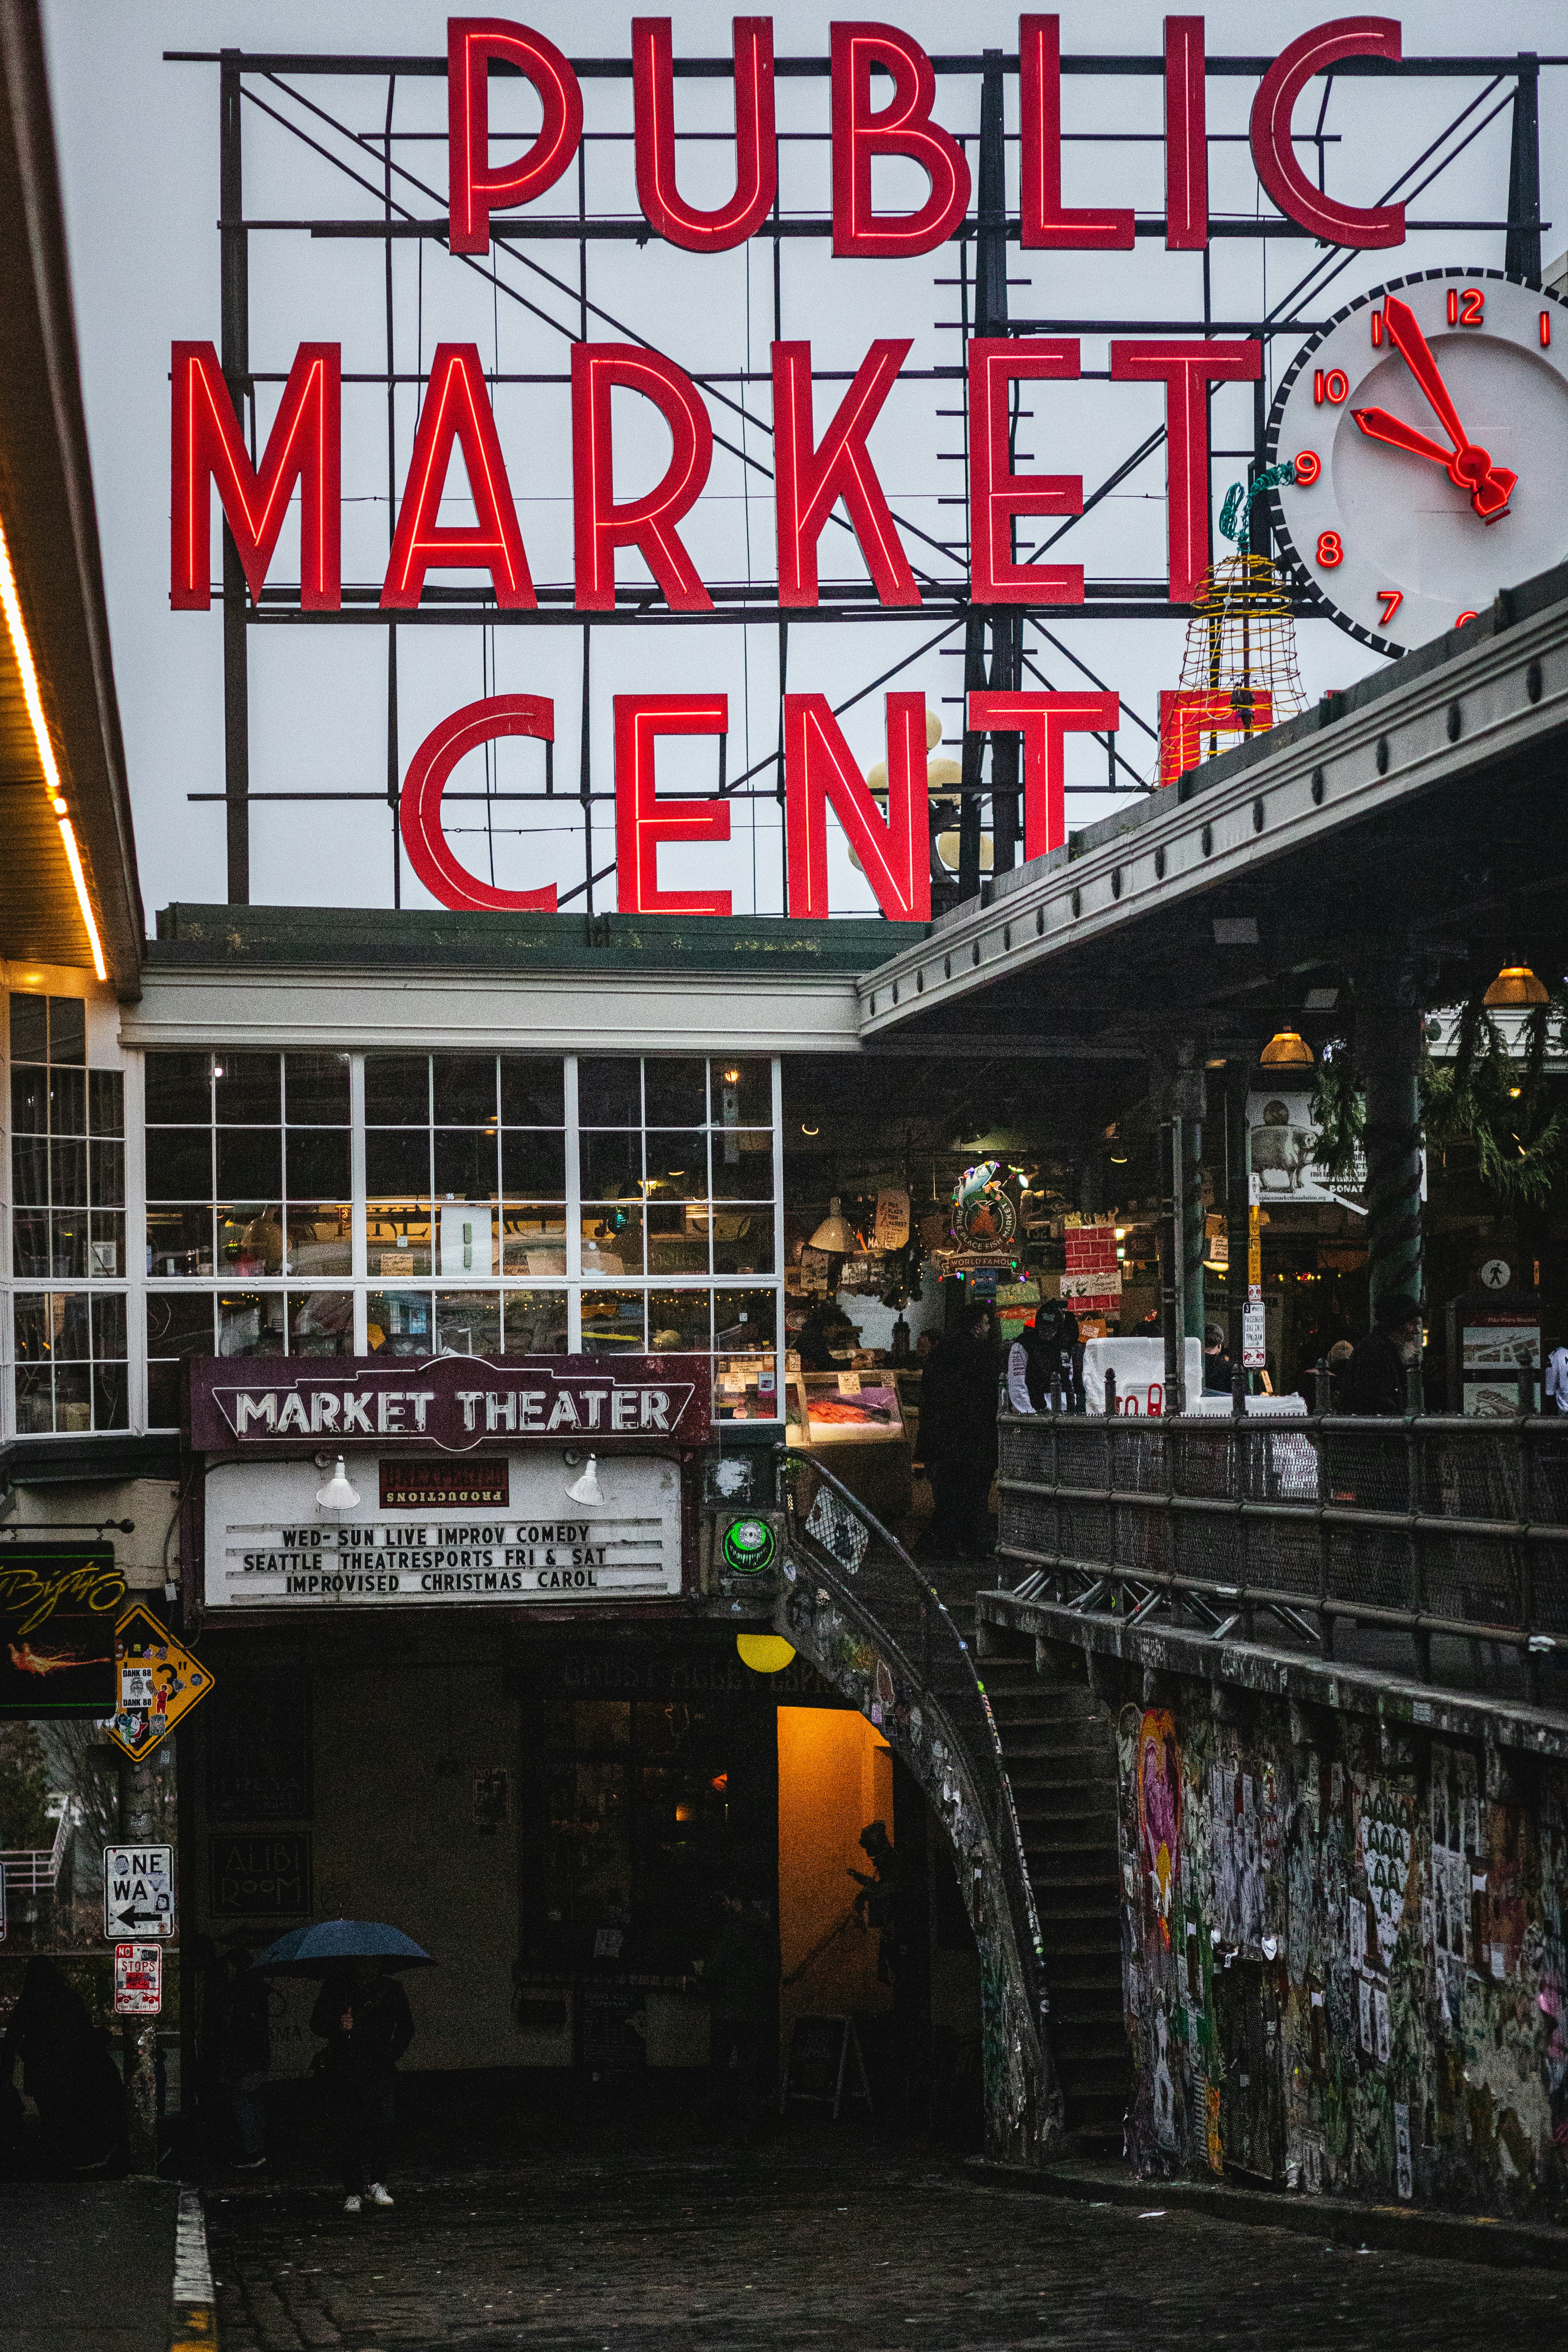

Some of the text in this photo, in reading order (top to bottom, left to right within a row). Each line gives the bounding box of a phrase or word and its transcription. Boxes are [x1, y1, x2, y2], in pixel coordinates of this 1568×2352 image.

[447, 16, 1406, 258] PUBLIC
[1447, 288, 1485, 325] 12
[1371, 310, 1397, 348] 1
[1314, 369, 1349, 404] 10
[170, 338, 1262, 612] MARKET
[1294, 450, 1321, 485] 9
[1316, 530, 1344, 568] 8
[1377, 590, 1404, 626] 7
[400, 689, 1274, 923] CENT
[960, 1232, 982, 1250] PLACE
[985, 1238, 1003, 1250] FISH
[1001, 1202, 1013, 1239] MARKET
[236, 1390, 670, 1433] MARKET THEATER
[386, 1491, 506, 1502] PRODUCTIONS
[282, 1526, 589, 1547] WED- SUN LIVE IMPROV COMEDY
[243, 1548, 606, 1571] SEATTLE THEATRESPORTS FRI & SAT
[287, 1570, 597, 1592] IMPROVISED CHRISTMAS CAROL
[225, 1842, 299, 1873] ALIBI
[118, 1947, 130, 1956] NO
[121, 1961, 155, 1972] STOPS
